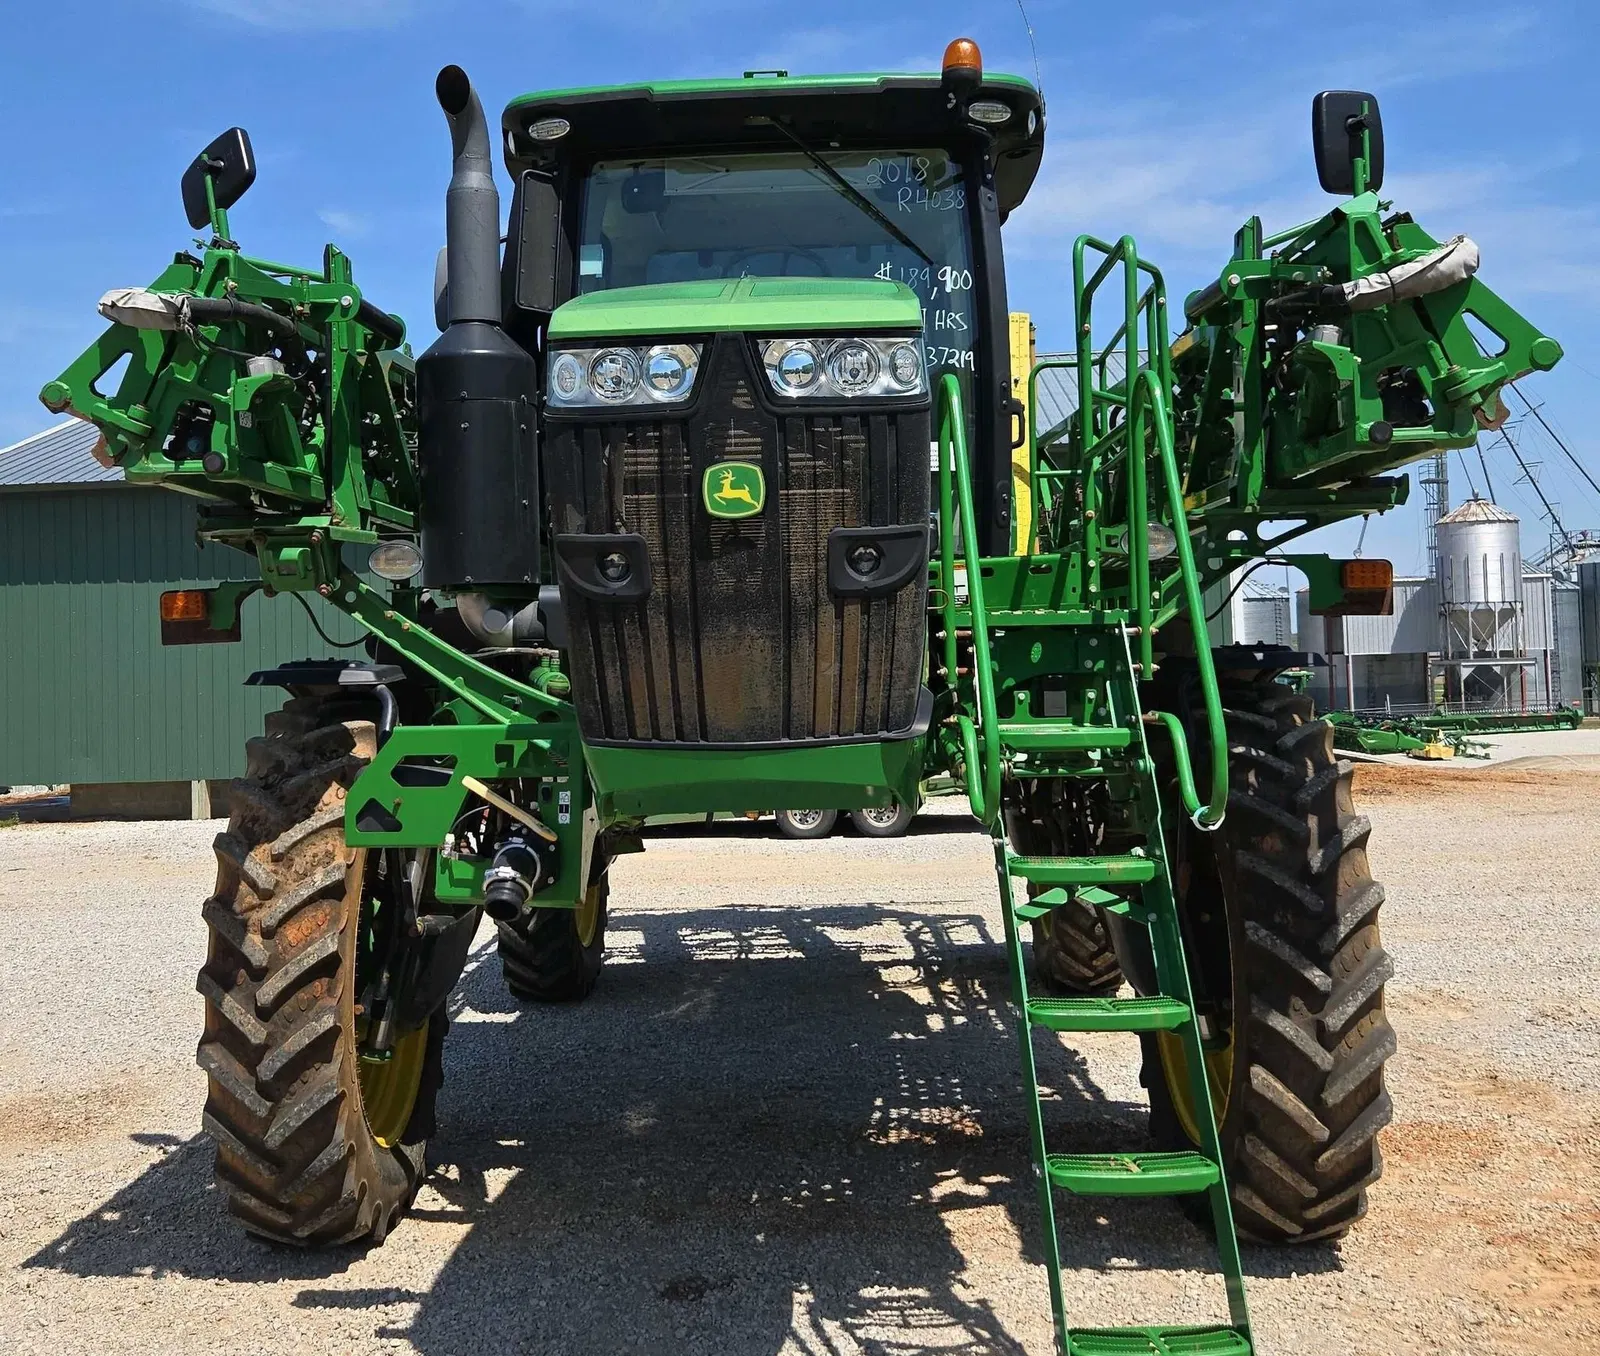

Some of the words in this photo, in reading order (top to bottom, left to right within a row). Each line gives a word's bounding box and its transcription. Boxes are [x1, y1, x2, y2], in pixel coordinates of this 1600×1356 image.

[866, 157, 930, 184] 2018
[897, 186, 965, 213] R4038
[935, 309, 968, 331] HRS
[926, 346, 975, 371] 37219
